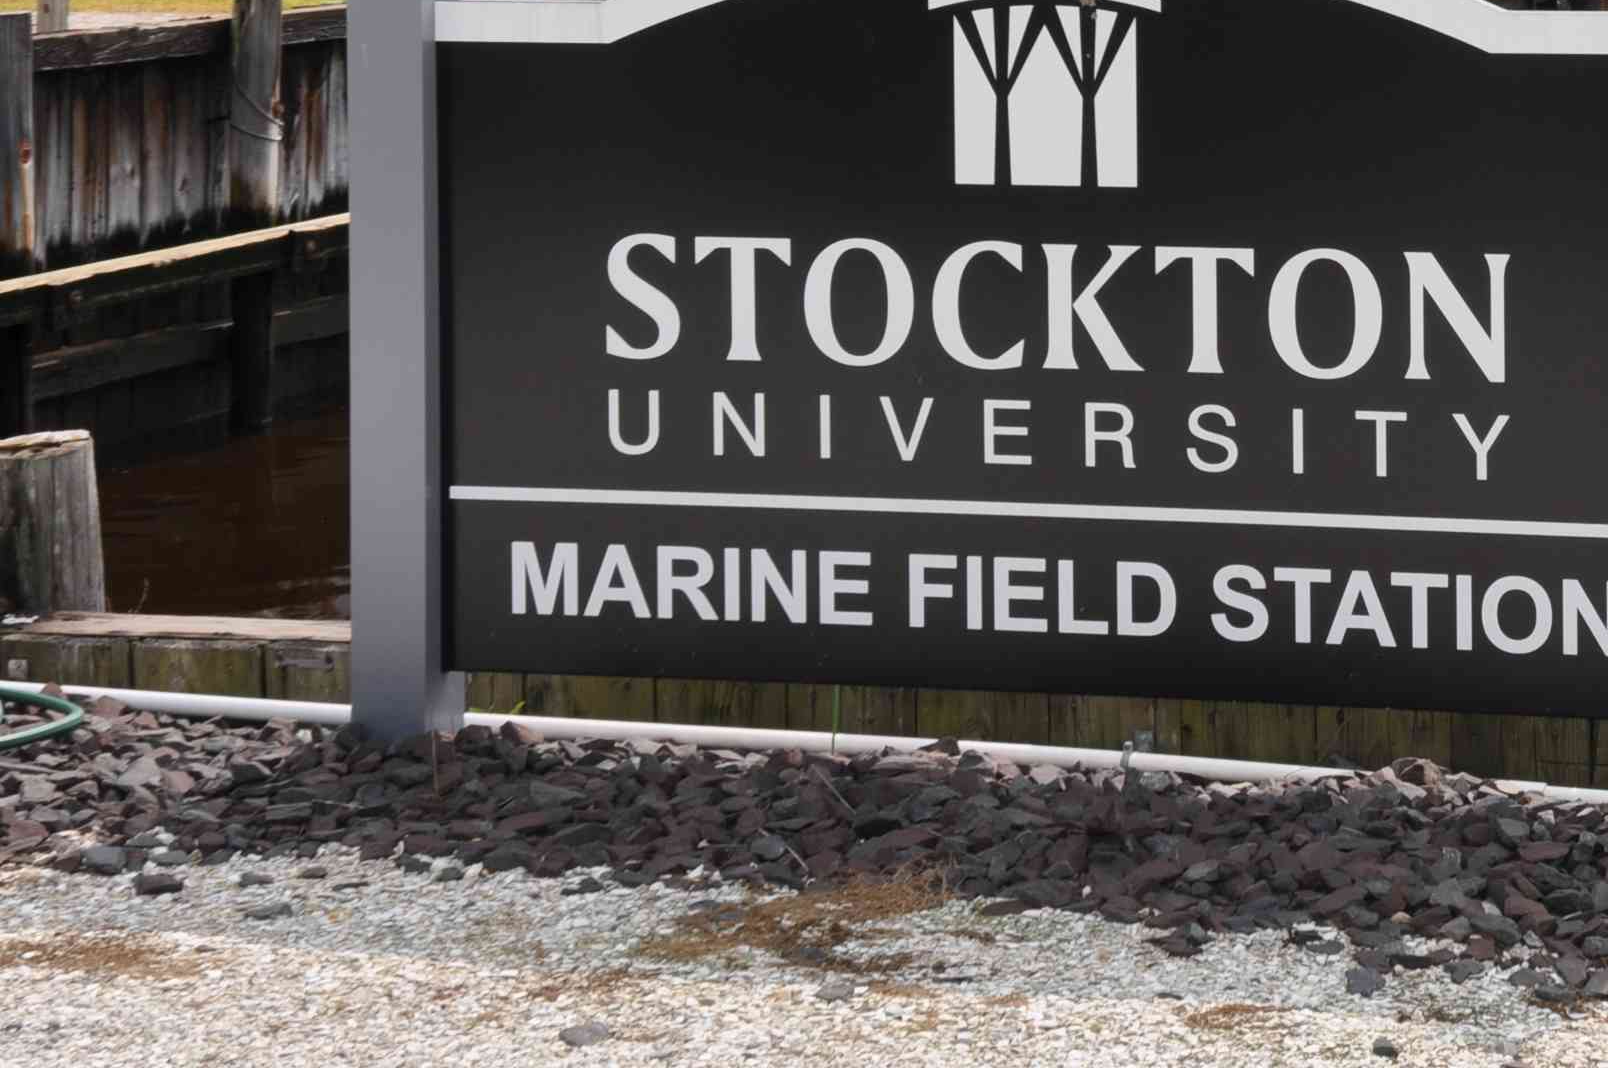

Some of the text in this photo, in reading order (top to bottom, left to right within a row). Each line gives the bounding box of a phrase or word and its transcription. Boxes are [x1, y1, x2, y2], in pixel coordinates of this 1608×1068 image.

[606, 233, 1510, 382] STOCKTON
[608, 389, 1509, 480] UNIVERSITY
[512, 541, 872, 625] MARINE
[909, 554, 1176, 636] FIELD
